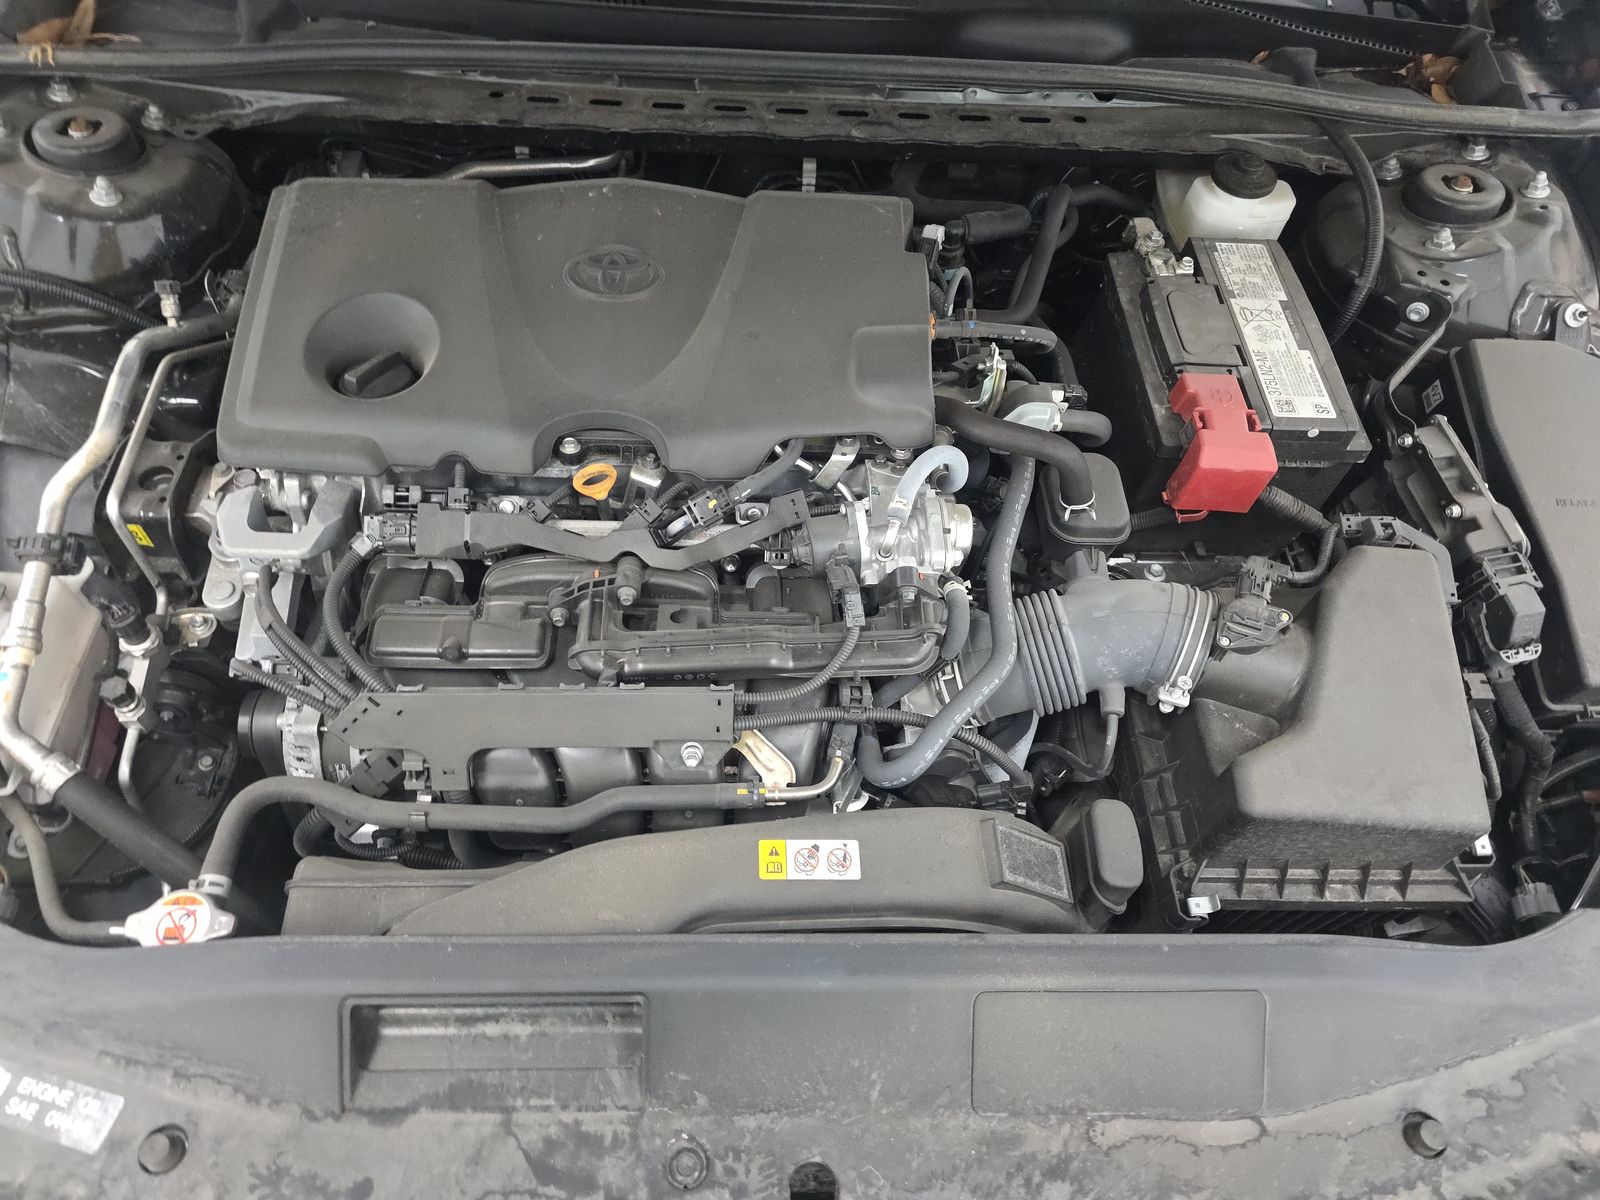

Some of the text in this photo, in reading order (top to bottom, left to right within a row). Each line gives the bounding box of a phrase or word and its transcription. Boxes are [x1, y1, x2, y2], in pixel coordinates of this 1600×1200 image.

[1253, 349, 1281, 396] 375LN2-MF
[1316, 404, 1331, 415] SP
[16, 1076, 74, 1108] ENGINE
[4, 1096, 40, 1121] SAE
